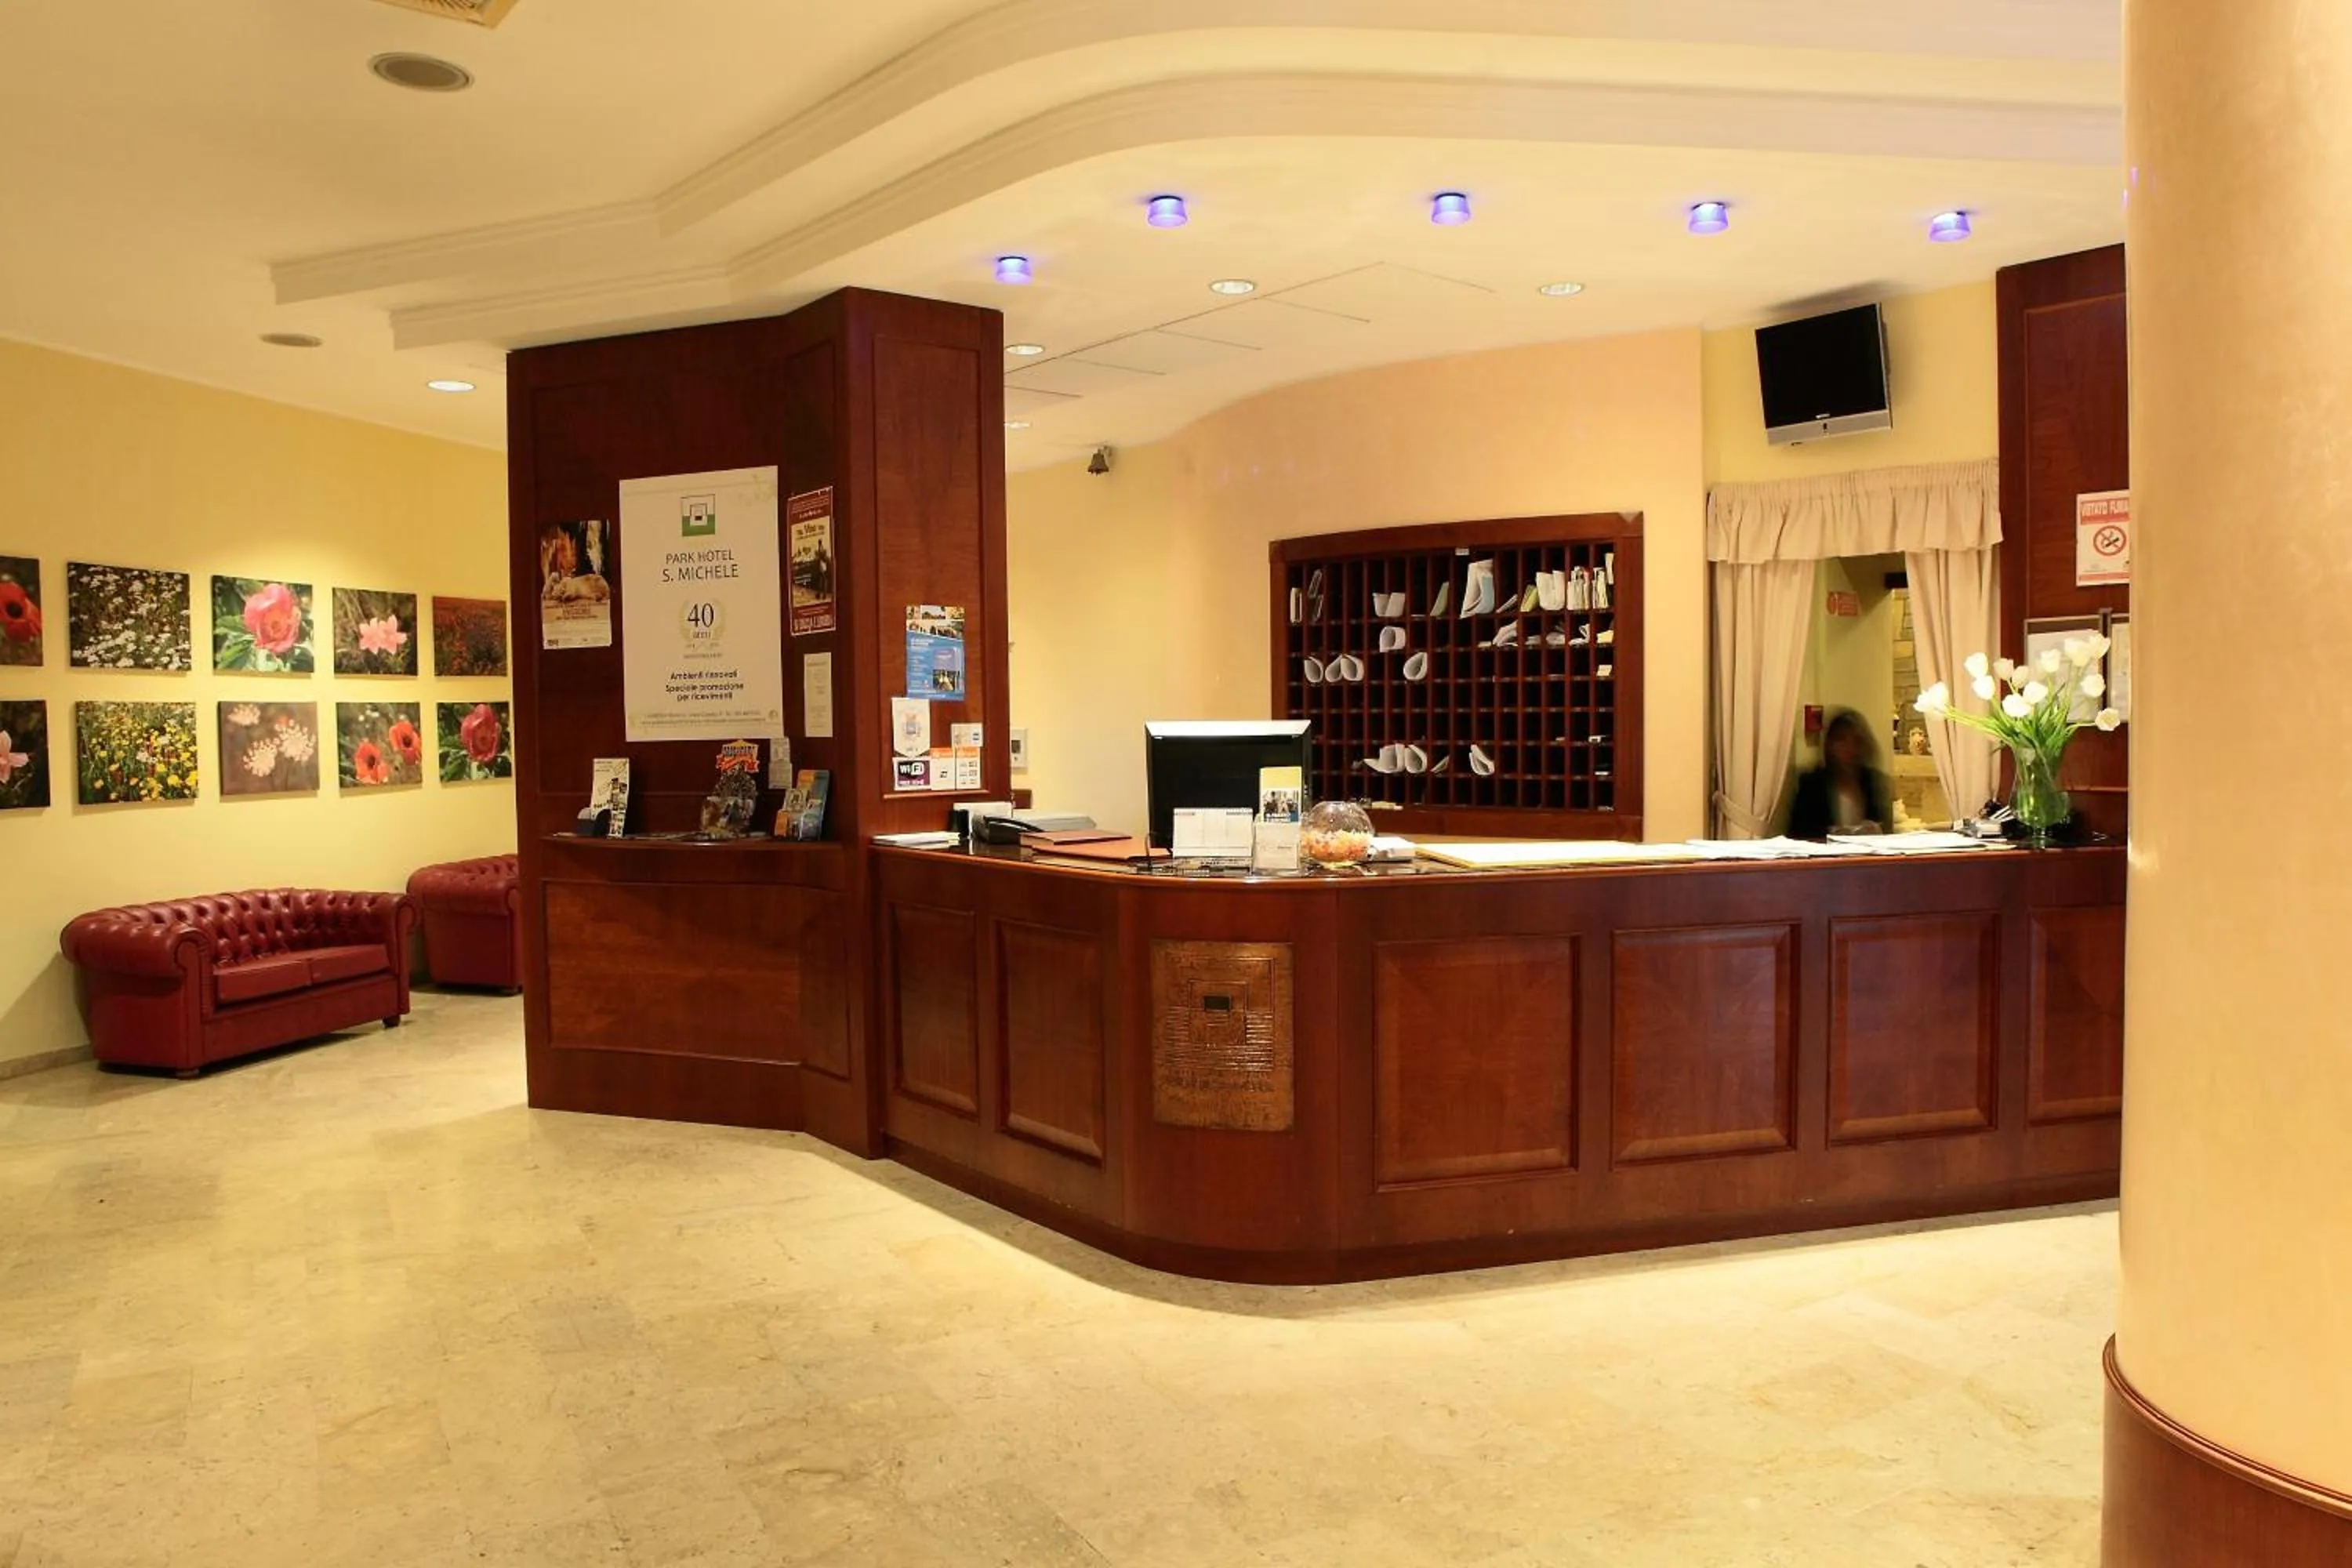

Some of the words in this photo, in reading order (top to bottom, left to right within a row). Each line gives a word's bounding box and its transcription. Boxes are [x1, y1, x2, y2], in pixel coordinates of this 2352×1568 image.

[666, 552, 695, 564] PARK
[698, 550, 735, 562] HOTEL
[662, 568, 673, 583] S.
[678, 564, 739, 580] MICHELE
[687, 603, 714, 627] 40
